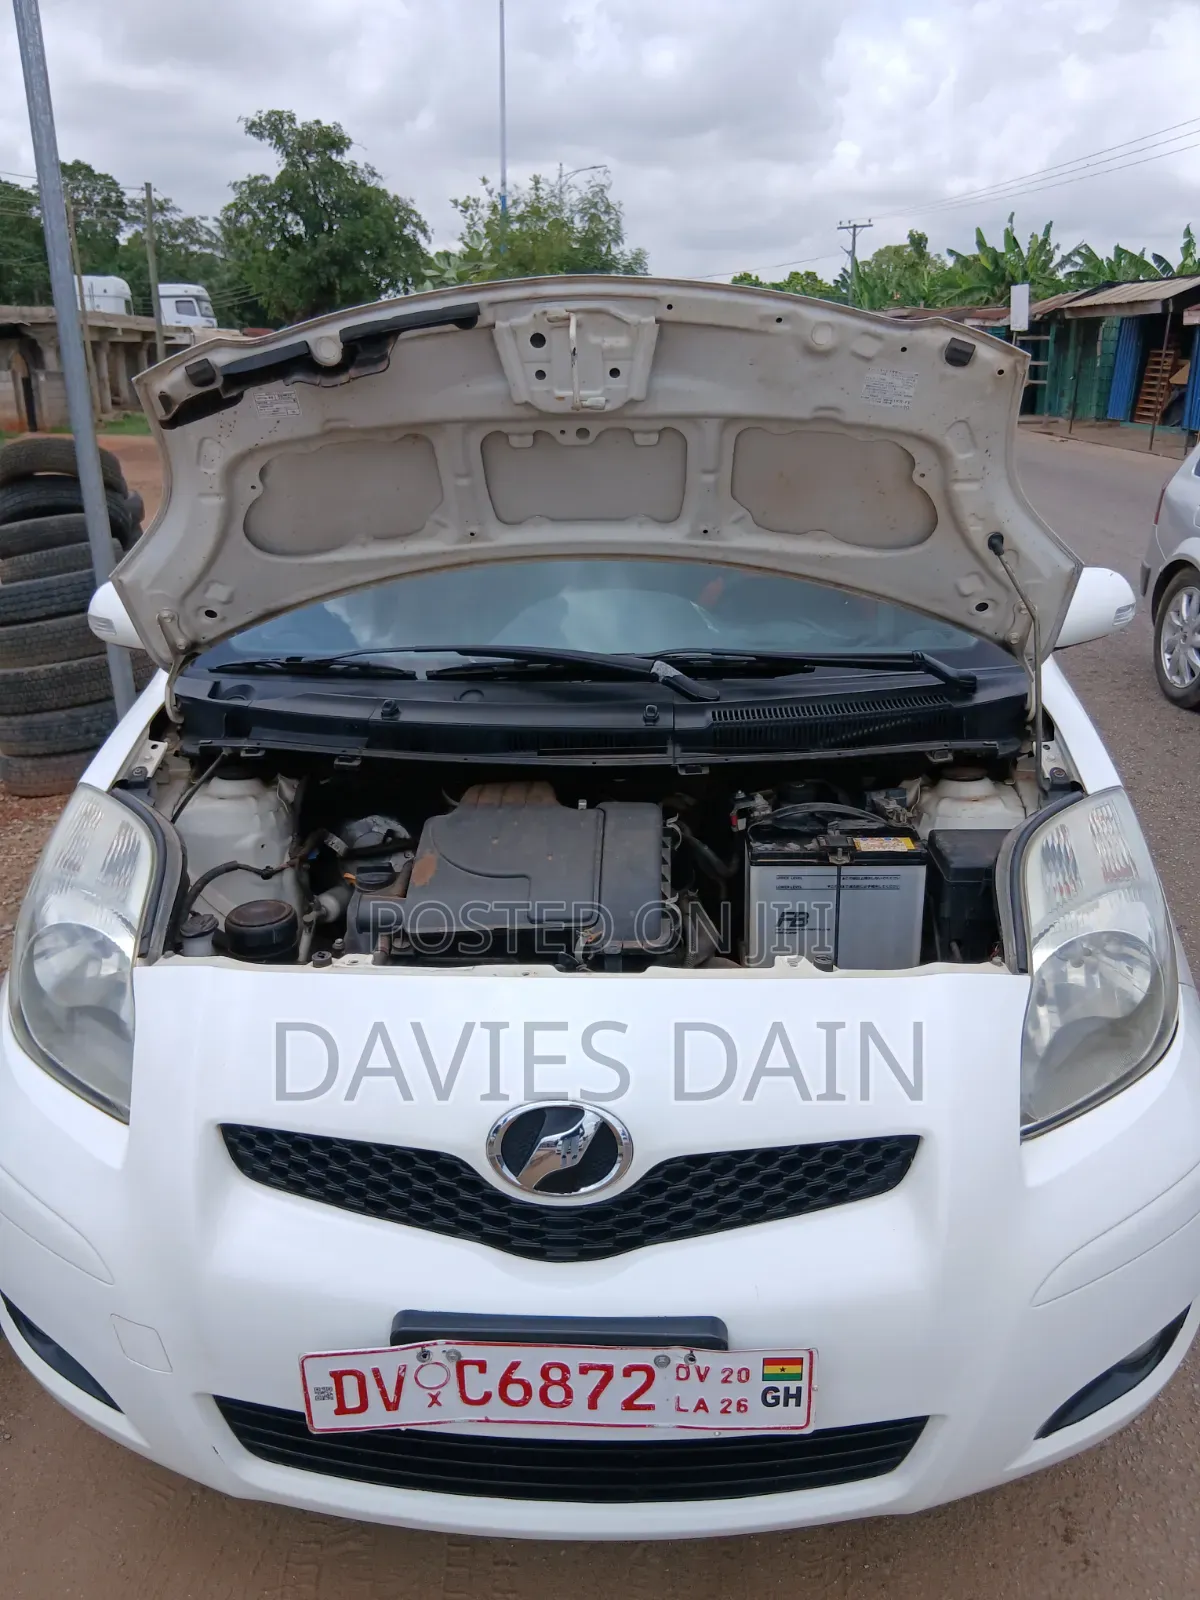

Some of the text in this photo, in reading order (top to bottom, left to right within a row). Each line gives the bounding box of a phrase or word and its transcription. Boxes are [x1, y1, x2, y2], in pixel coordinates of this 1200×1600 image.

[777, 911, 809, 928] FB
[675, 1363, 751, 1384] DV 20
[329, 1359, 656, 1416] DV C6872
[760, 1385, 803, 1408] GH
[674, 1395, 749, 1414] LA 26
